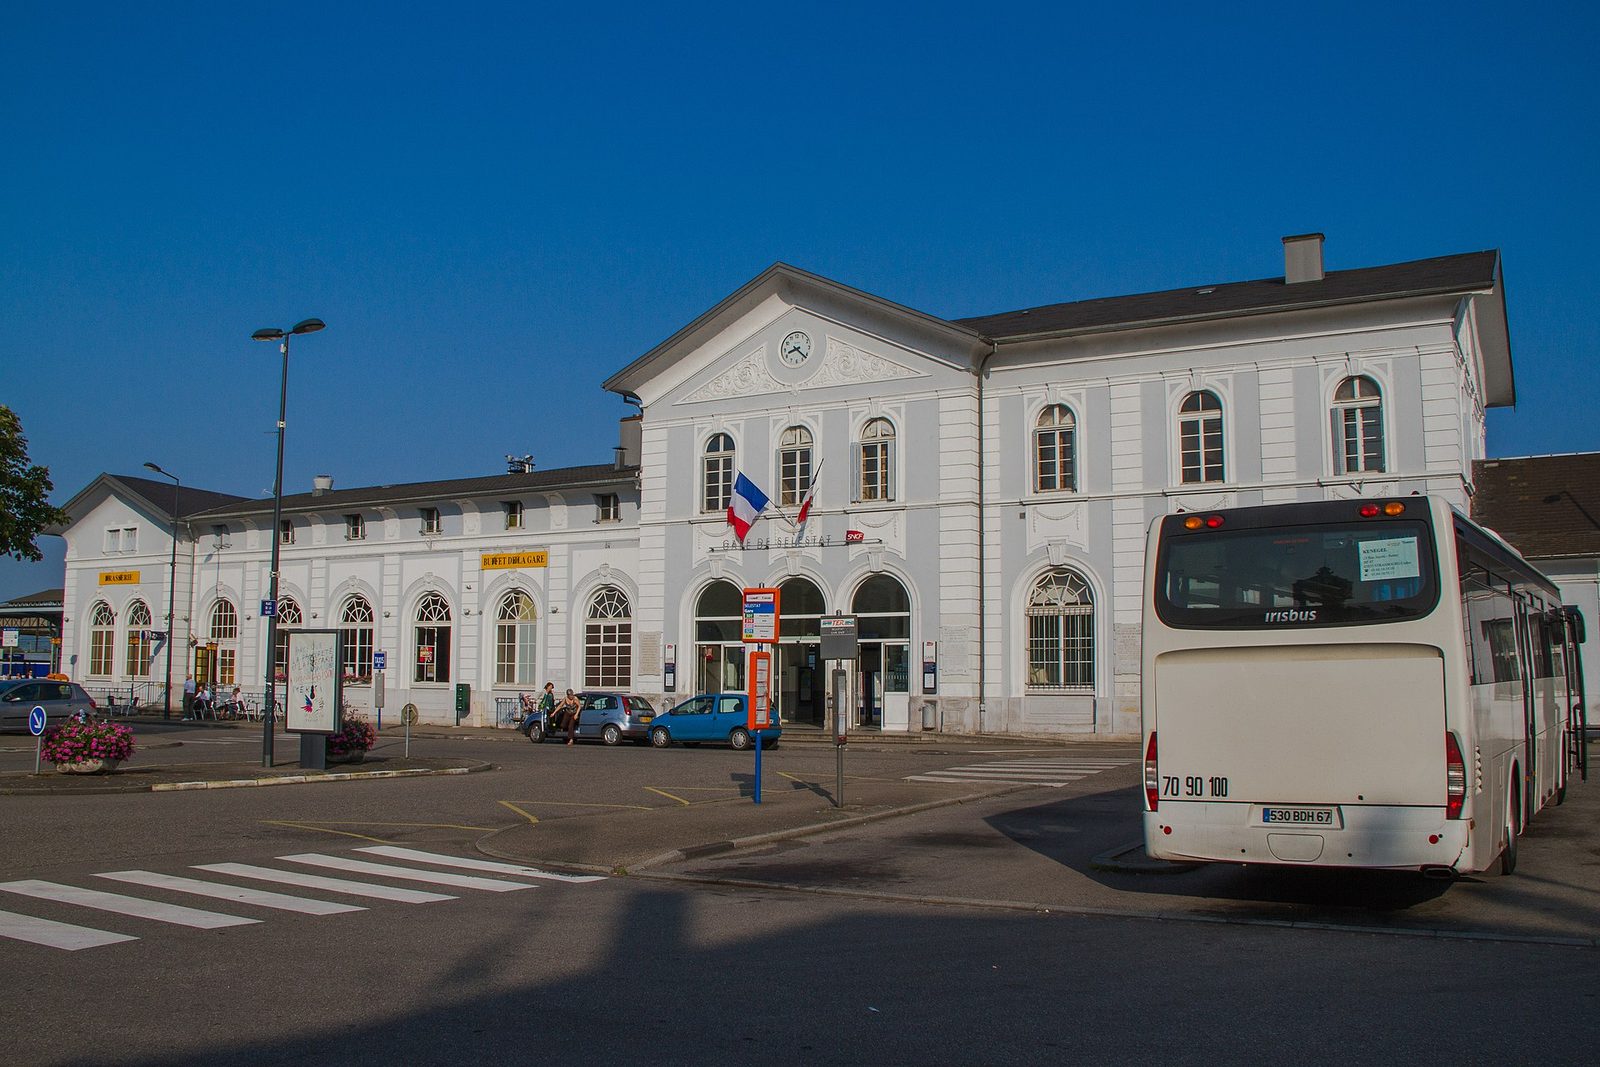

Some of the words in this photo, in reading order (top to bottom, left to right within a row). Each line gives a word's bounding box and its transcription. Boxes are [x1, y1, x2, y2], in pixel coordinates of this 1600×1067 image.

[847, 533, 863, 541] SNCF
[723, 538, 751, 550] GAE
[483, 557, 507, 566] BUFFET
[527, 555, 545, 564] GARE
[1264, 609, 1318, 623] irisbus
[831, 619, 845, 627] TER
[1162, 775, 1180, 797] 70
[1185, 776, 1203, 797] 90
[1208, 776, 1228, 798] 100
[1270, 810, 1291, 821] 530
[1293, 810, 1315, 822] BDH
[1316, 811, 1331, 822] 67
